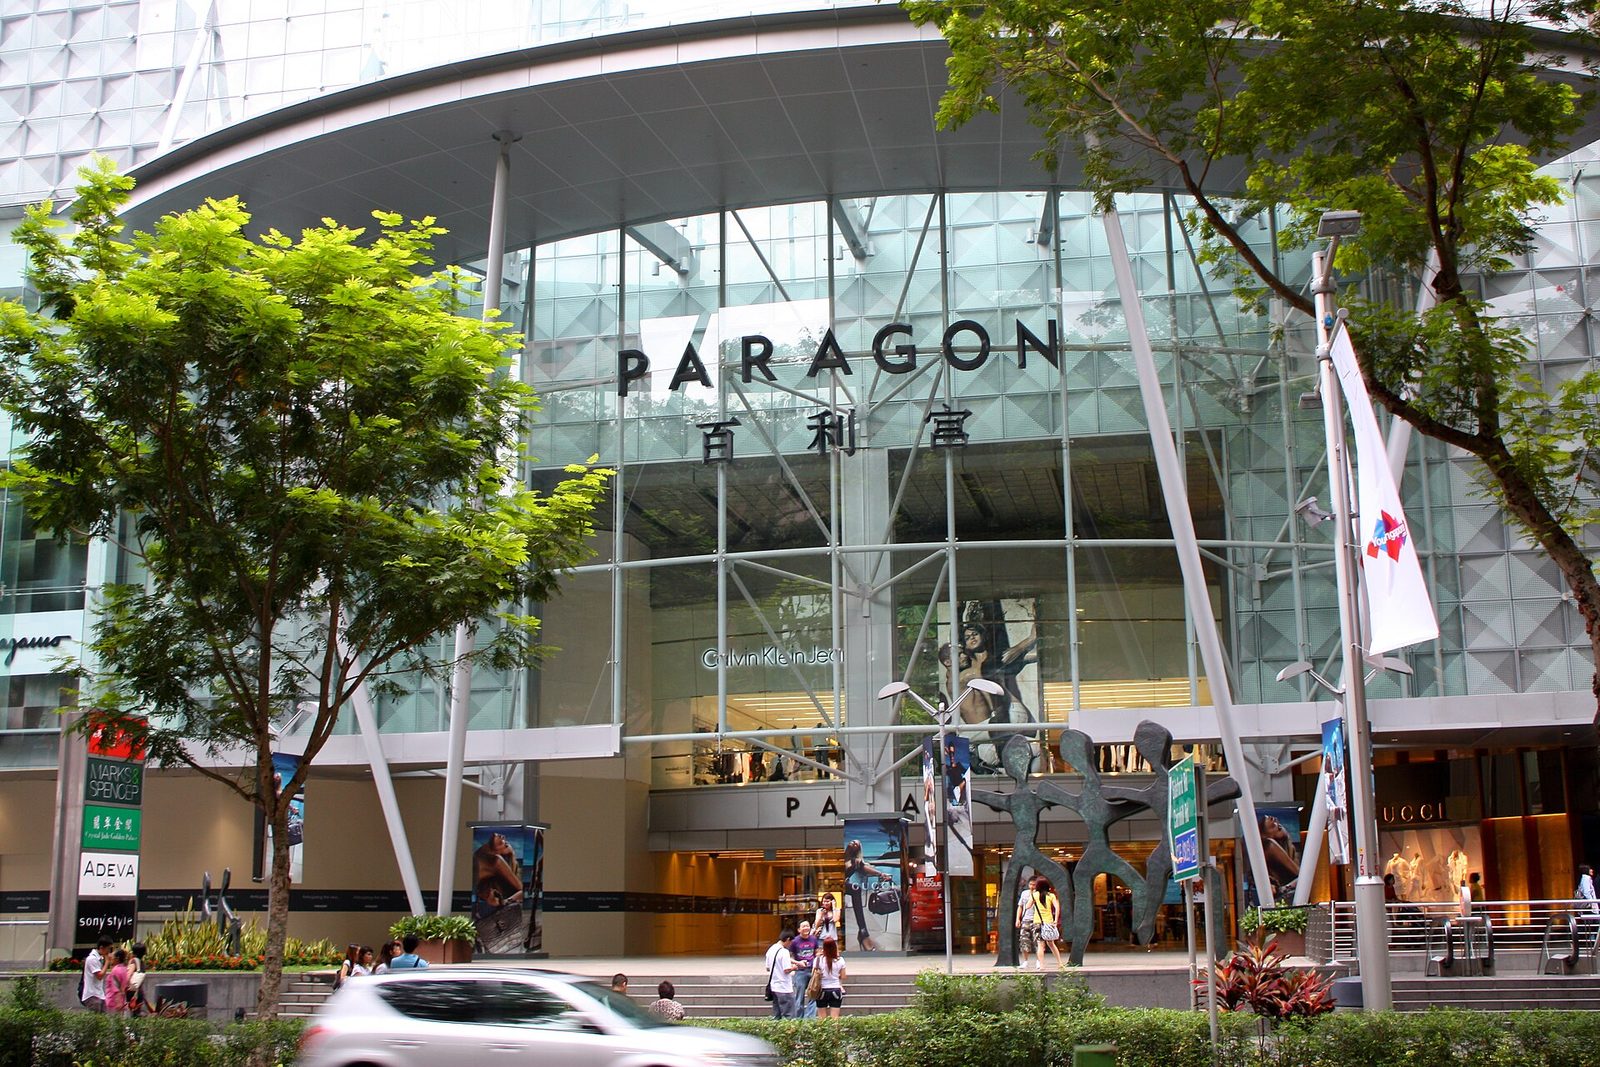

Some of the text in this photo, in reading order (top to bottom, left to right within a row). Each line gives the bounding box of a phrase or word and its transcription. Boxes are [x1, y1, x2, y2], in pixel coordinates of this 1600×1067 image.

[618, 319, 1058, 397] PARAGON
[762, 646, 805, 665] Klein
[90, 764, 140, 784] MARKS &
[89, 780, 139, 800] SPENCER
[1383, 802, 1443, 824] UCCI
[83, 860, 135, 878] ADEVA
[851, 882, 895, 891] GUCCI
[79, 915, 133, 932] sony style
